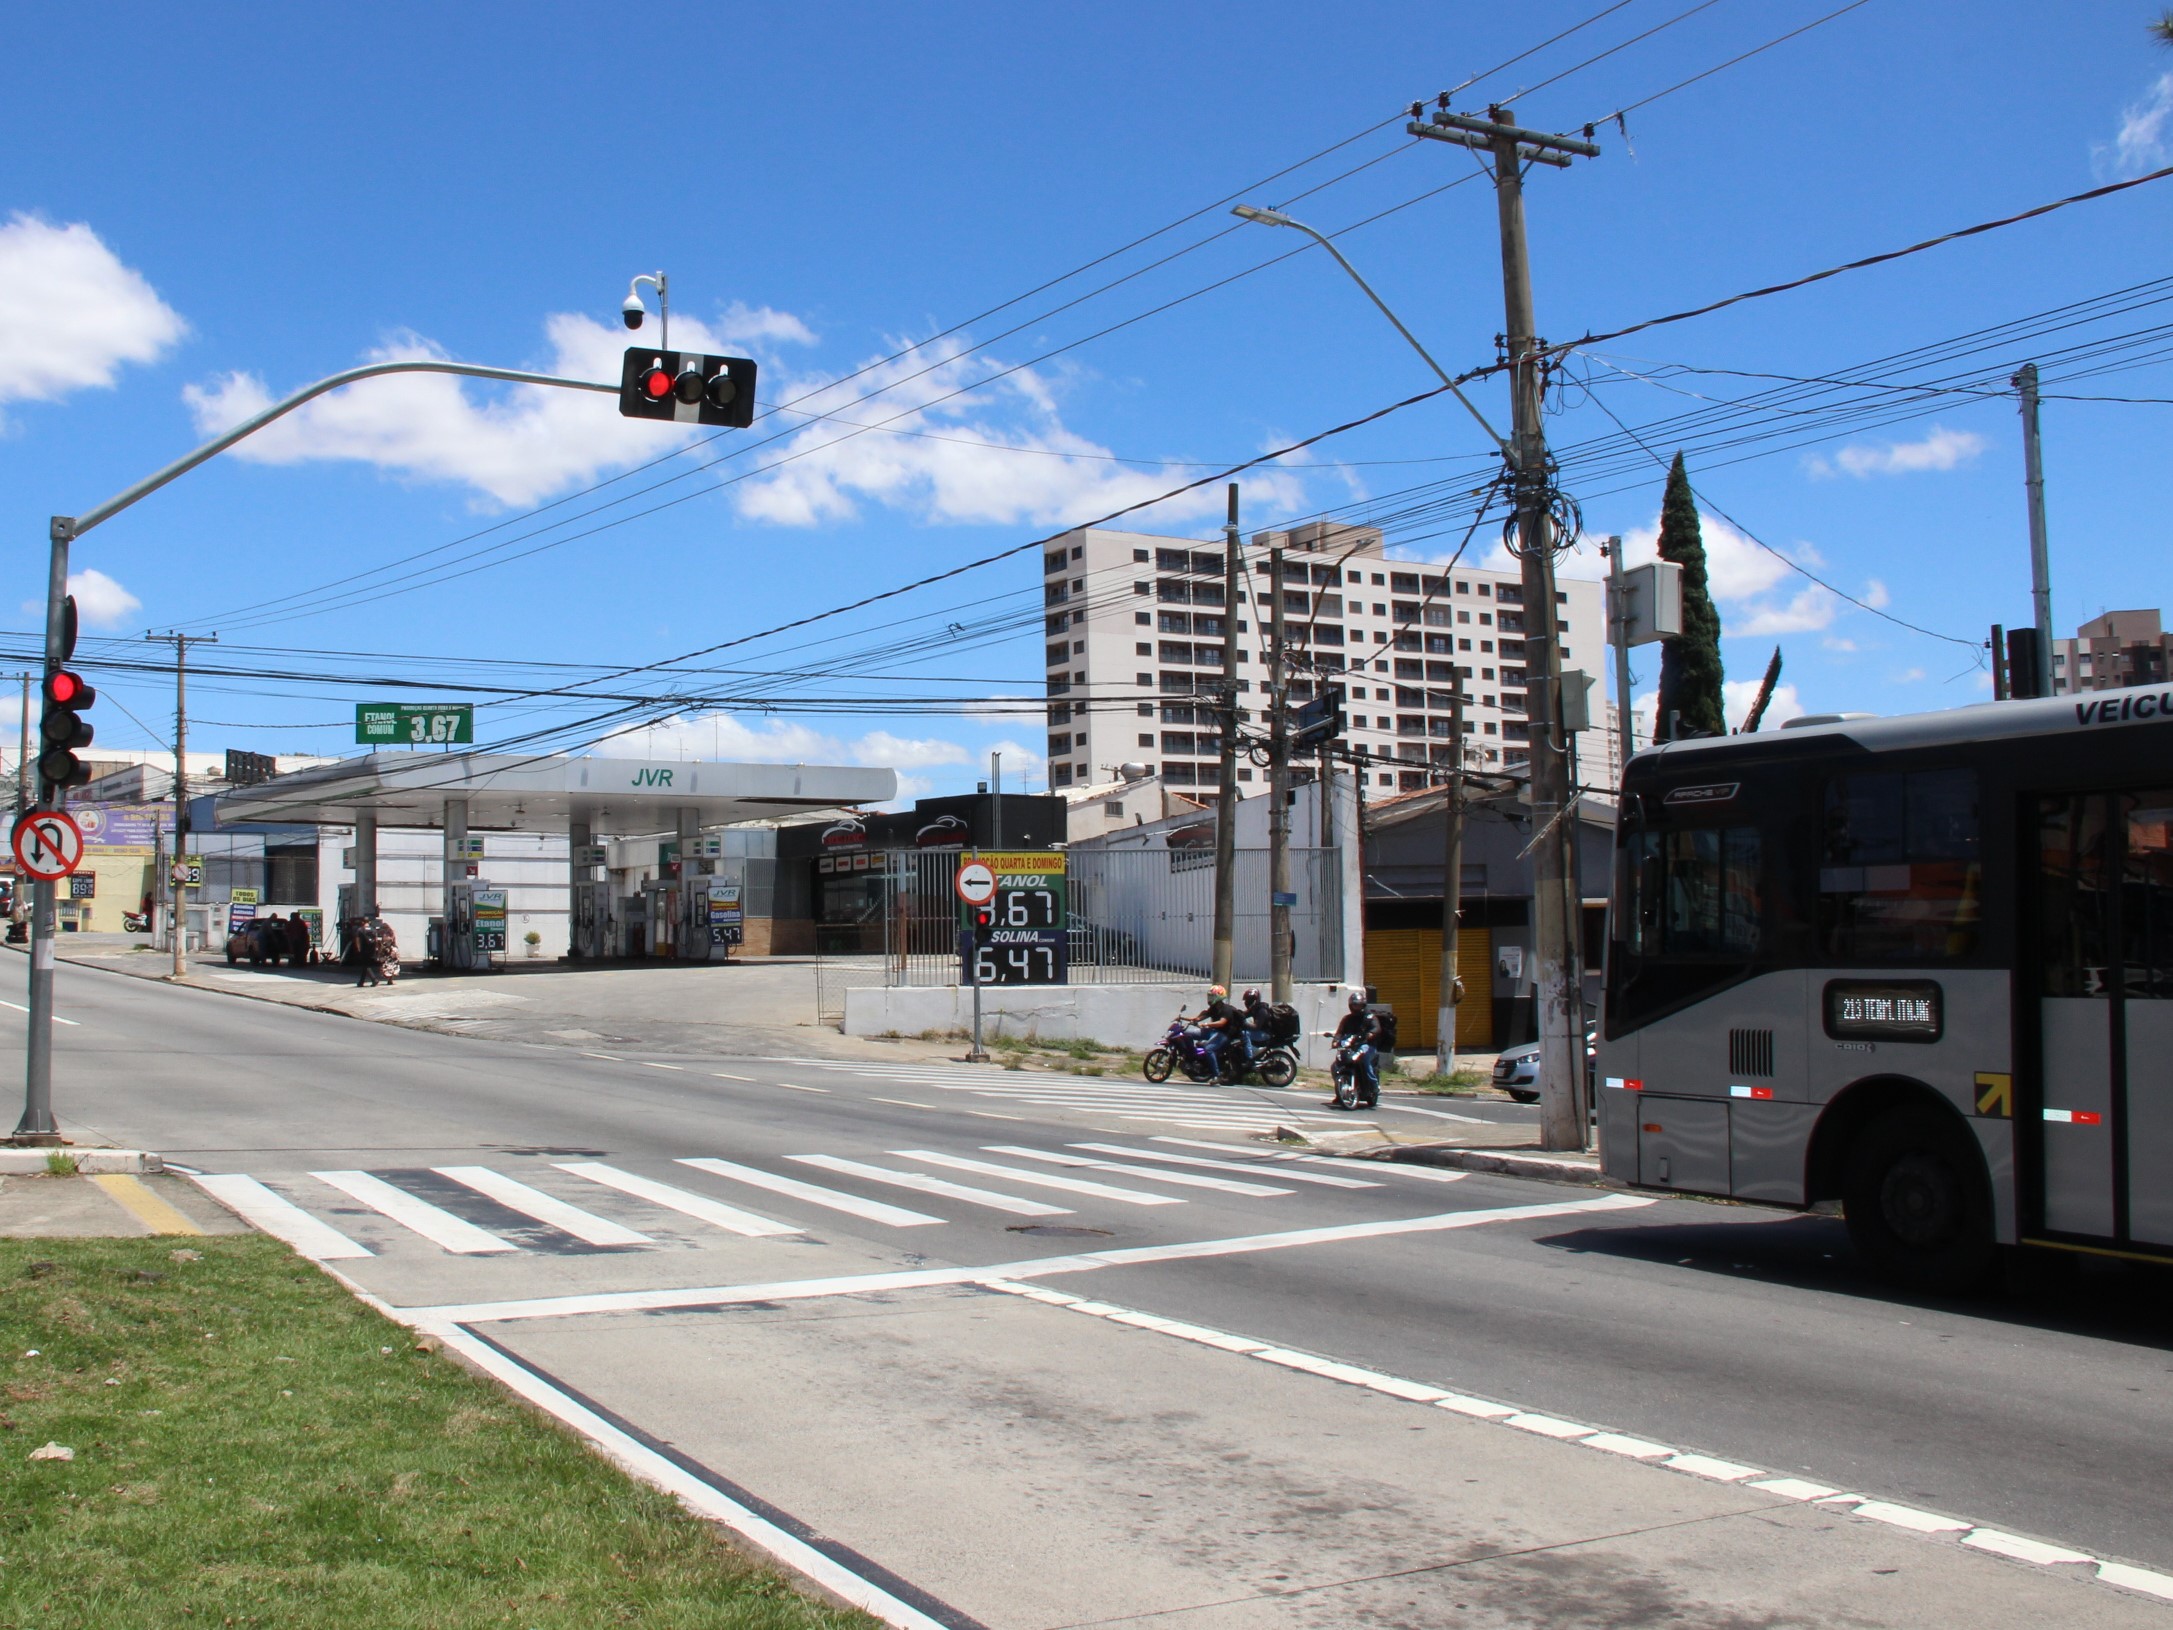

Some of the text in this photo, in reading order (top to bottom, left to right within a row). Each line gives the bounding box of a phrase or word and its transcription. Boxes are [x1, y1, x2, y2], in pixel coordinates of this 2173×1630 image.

[365, 712, 397, 724] ETANOL
[367, 725, 394, 735] COMUM
[411, 715, 460, 743] 3,67
[631, 768, 673, 787] JVR
[1000, 857, 1025, 870] QUARTA
[1027, 857, 1031, 869] E
[1033, 857, 1062, 869] DOMINGO
[996, 875, 1048, 888] ANOL
[713, 889, 736, 897] JVR
[711, 910, 740, 919] Gasolina
[475, 919, 504, 928] Etanol
[478, 933, 504, 949] 3,67
[713, 927, 740, 943] 5,47
[991, 930, 1039, 943] SOLINA
[1843, 998, 1861, 1019] 213
